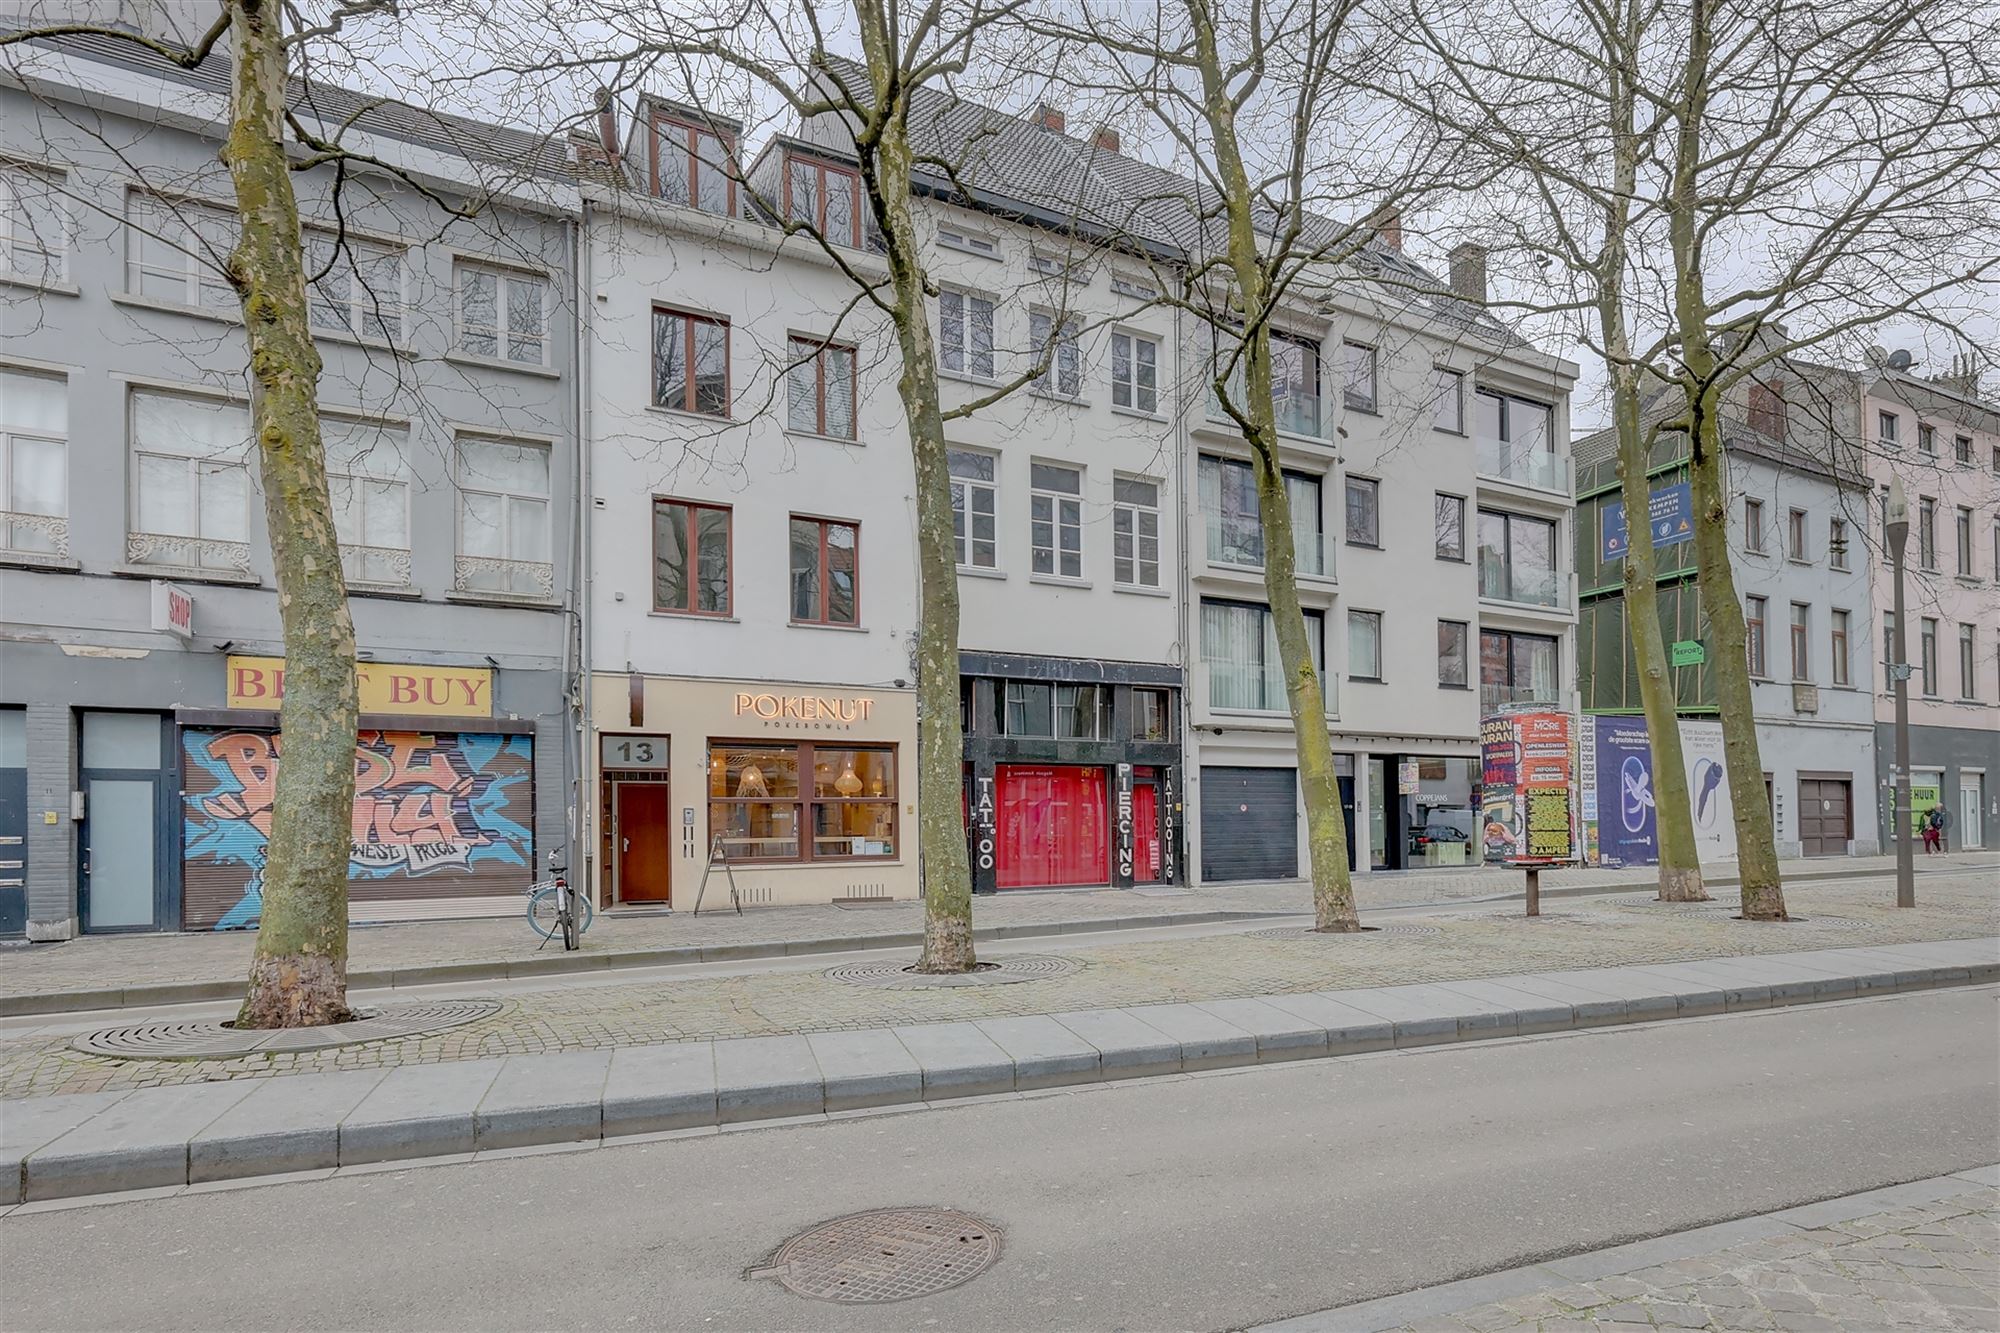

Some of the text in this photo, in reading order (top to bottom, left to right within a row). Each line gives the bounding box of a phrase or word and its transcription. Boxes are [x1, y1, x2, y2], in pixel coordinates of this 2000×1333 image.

[168, 591, 191, 629] SHOP
[389, 675, 486, 706] BUY
[734, 693, 875, 722] POKENUT
[617, 742, 653, 762] 13
[1914, 789, 1935, 800] HUUR
[1119, 763, 1132, 876] PIERCING
[1165, 767, 1174, 878] TATTOOING
